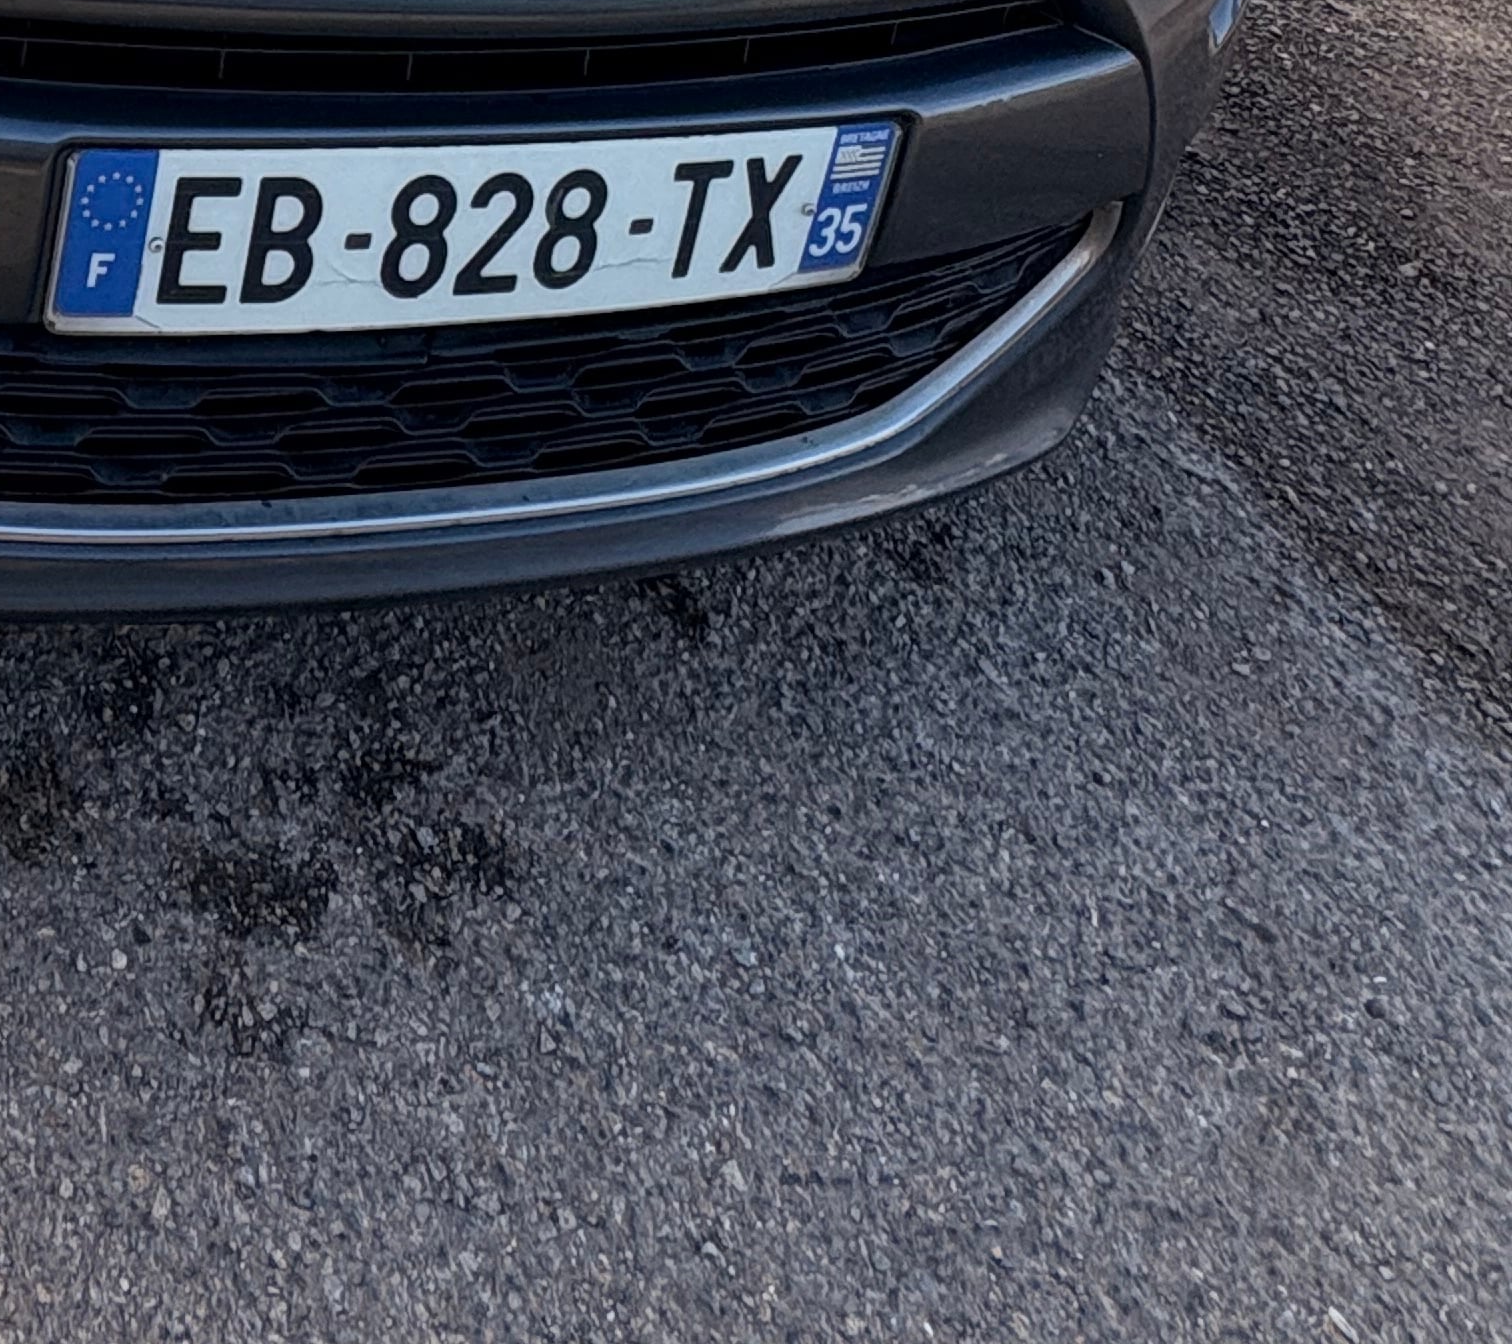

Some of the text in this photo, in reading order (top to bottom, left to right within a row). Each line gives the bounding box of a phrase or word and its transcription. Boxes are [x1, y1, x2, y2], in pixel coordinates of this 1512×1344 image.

[156, 154, 804, 305] EB-828-TX
[808, 203, 868, 257] 35
[87, 252, 116, 288] F
